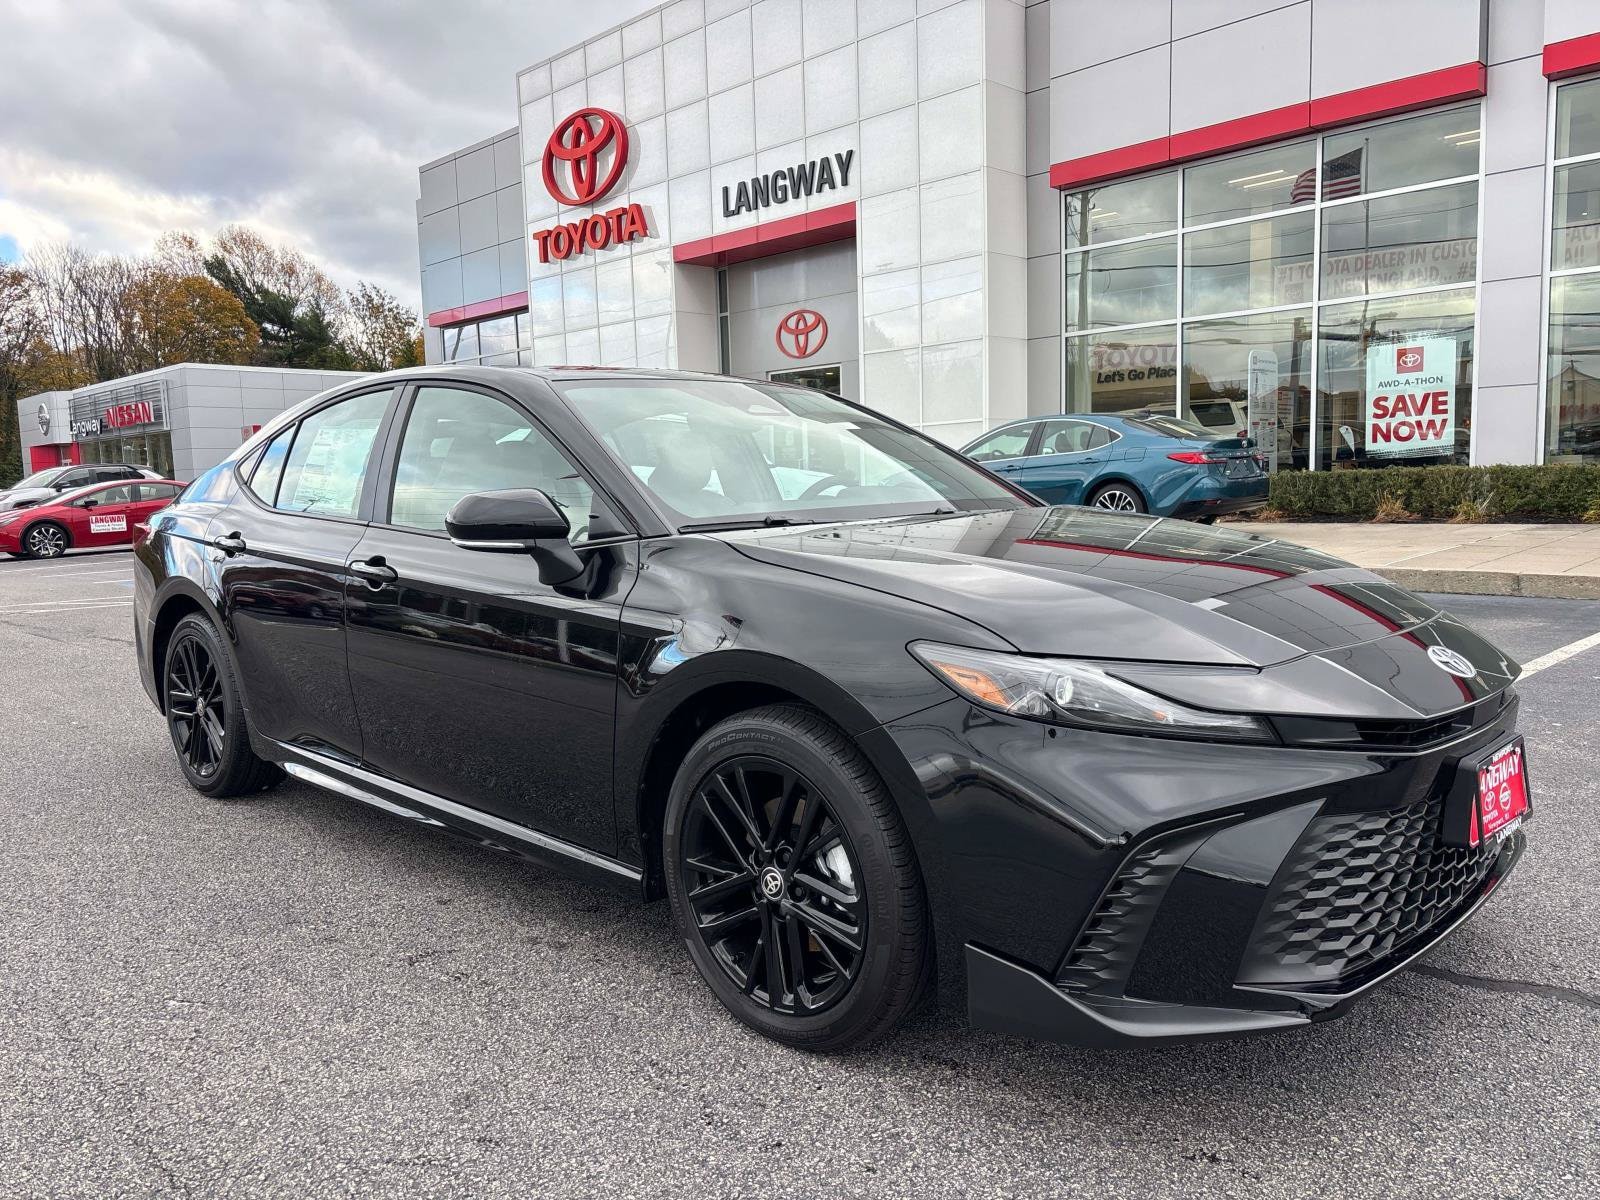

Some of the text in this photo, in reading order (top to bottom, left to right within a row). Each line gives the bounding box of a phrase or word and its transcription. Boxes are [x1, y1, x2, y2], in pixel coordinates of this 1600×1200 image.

[722, 149, 854, 218] LANGWAY
[533, 203, 649, 263] TOYOTA
[1299, 258, 1350, 280] TOOTA
[1354, 251, 1406, 272] DEALER
[1410, 246, 1427, 265] IN
[1096, 366, 1177, 384] Let's Go Plac
[1378, 376, 1443, 388] AWD-A-THON
[106, 402, 152, 428] NISSAN
[1372, 391, 1448, 419] SAVE
[1371, 419, 1448, 443] NOW
[91, 515, 125, 524] LANGWAY
[1480, 752, 1521, 794] ANGWAY
[1495, 815, 1522, 844] LANGWAY
